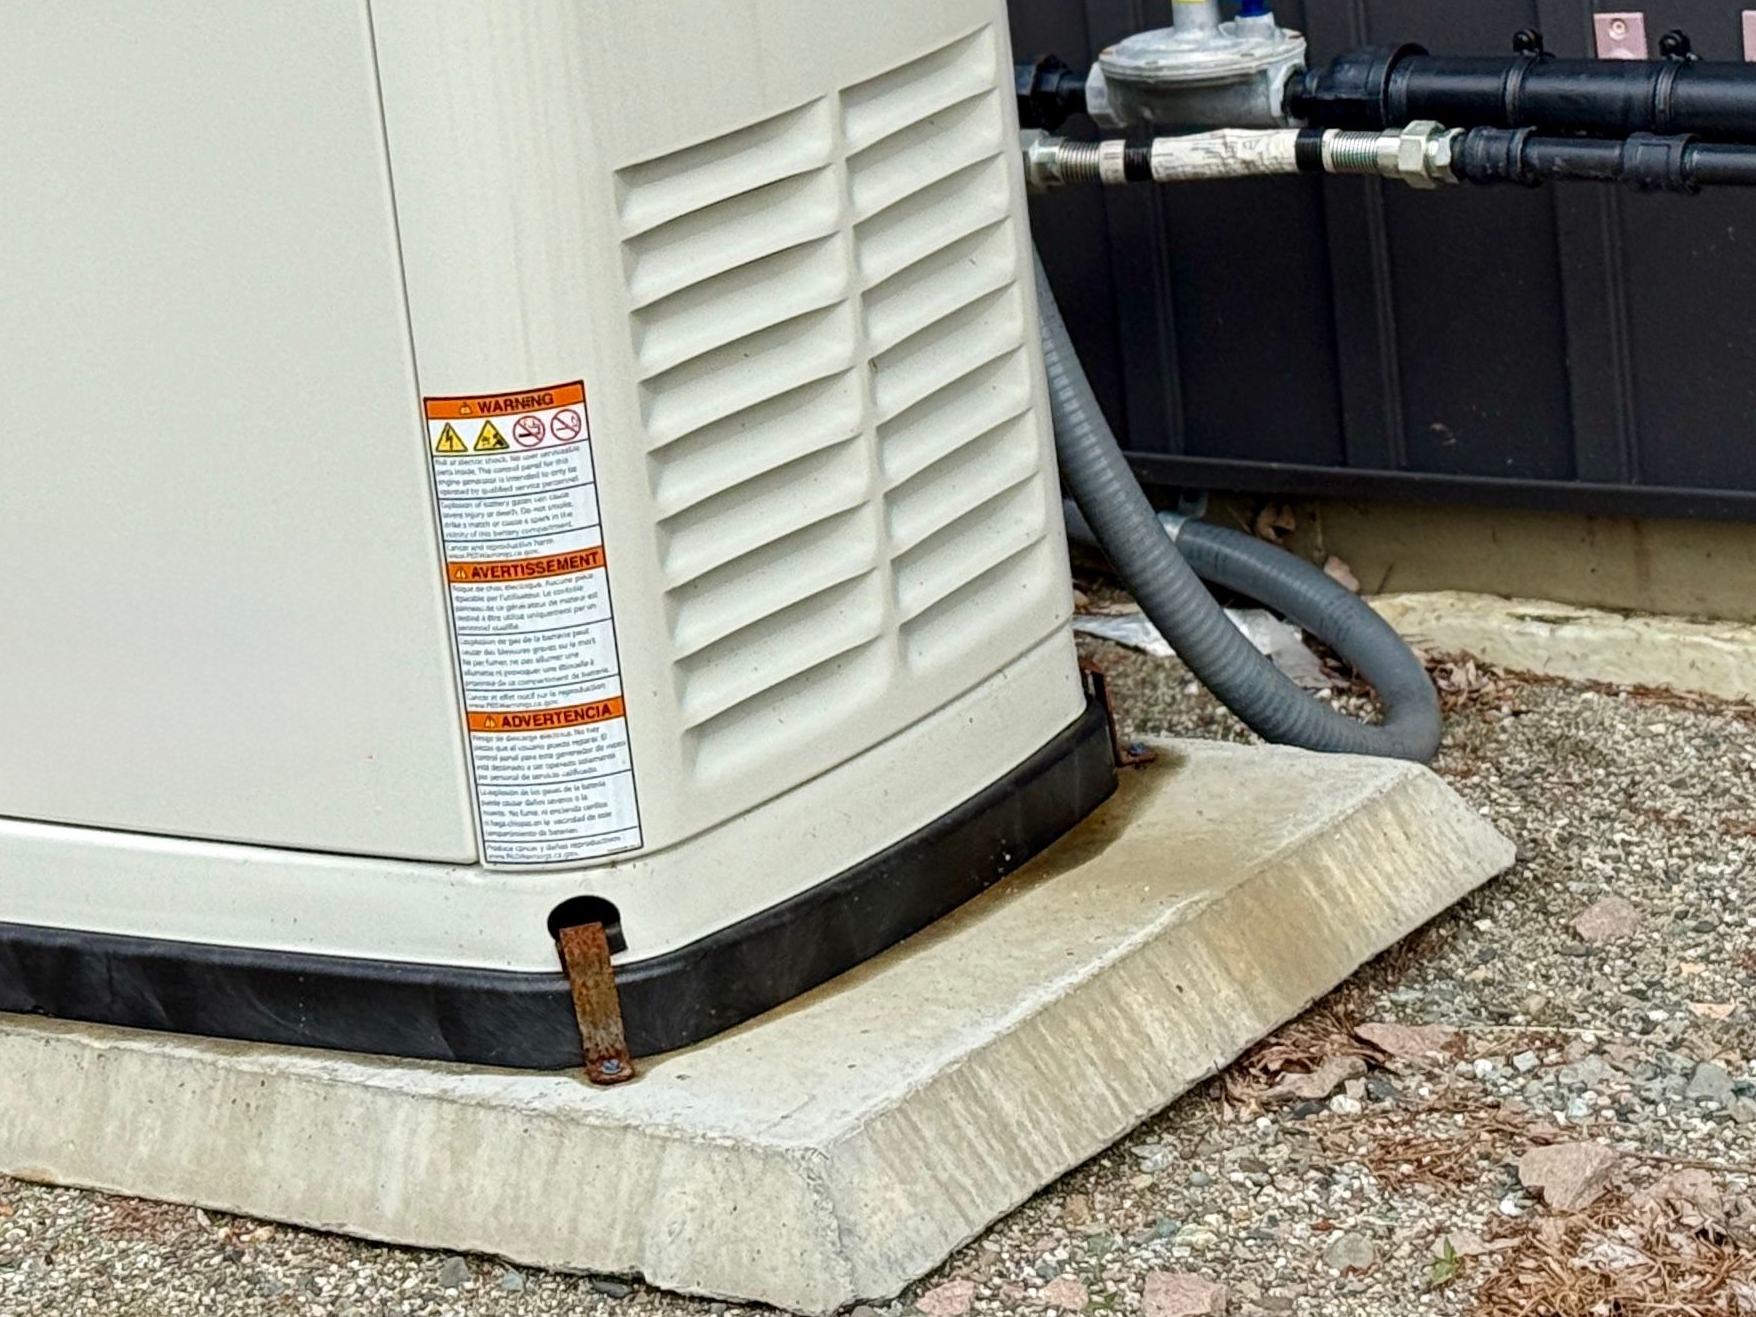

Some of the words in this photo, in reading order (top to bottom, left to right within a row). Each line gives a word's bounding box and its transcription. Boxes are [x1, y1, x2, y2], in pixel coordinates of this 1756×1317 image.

[478, 393, 553, 412] WARNING
[472, 552, 597, 578] AVERTISSEMENT
[502, 704, 611, 727] ADVERTENCIA
